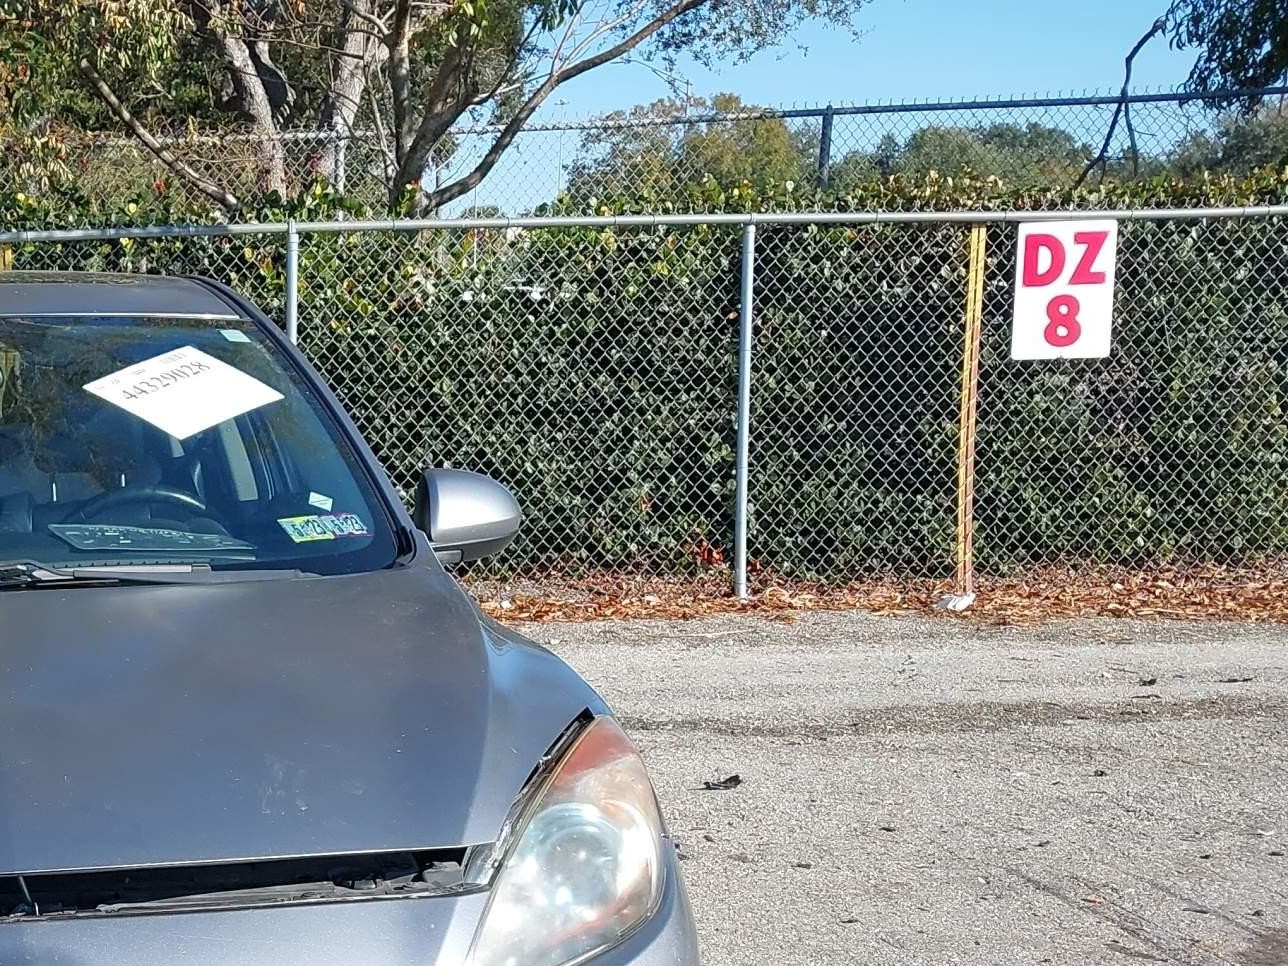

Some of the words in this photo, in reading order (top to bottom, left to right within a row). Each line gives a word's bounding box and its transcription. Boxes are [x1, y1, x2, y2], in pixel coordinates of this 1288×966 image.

[1022, 231, 1109, 287] DZ
[1043, 294, 1081, 347] 8
[122, 360, 211, 401] 44329028
